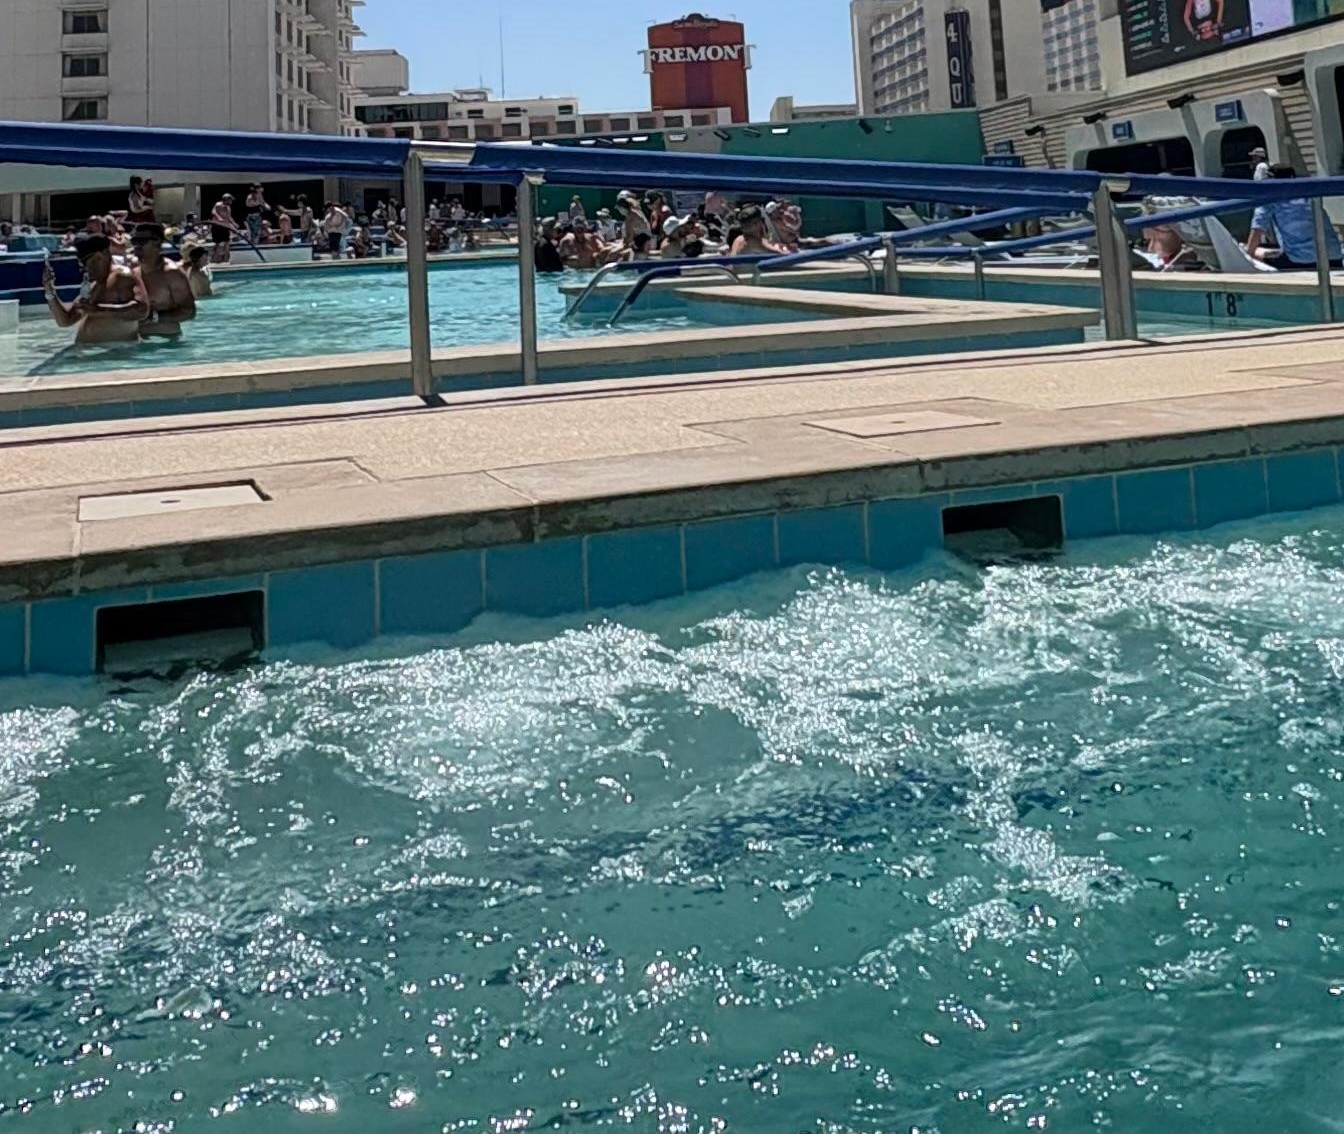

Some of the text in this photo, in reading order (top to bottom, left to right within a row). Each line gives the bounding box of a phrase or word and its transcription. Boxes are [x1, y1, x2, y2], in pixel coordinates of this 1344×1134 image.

[947, 22, 958, 42] 4
[637, 44, 757, 74] FREMONT
[1206, 291, 1214, 316] 1
[1226, 293, 1237, 317] 8
